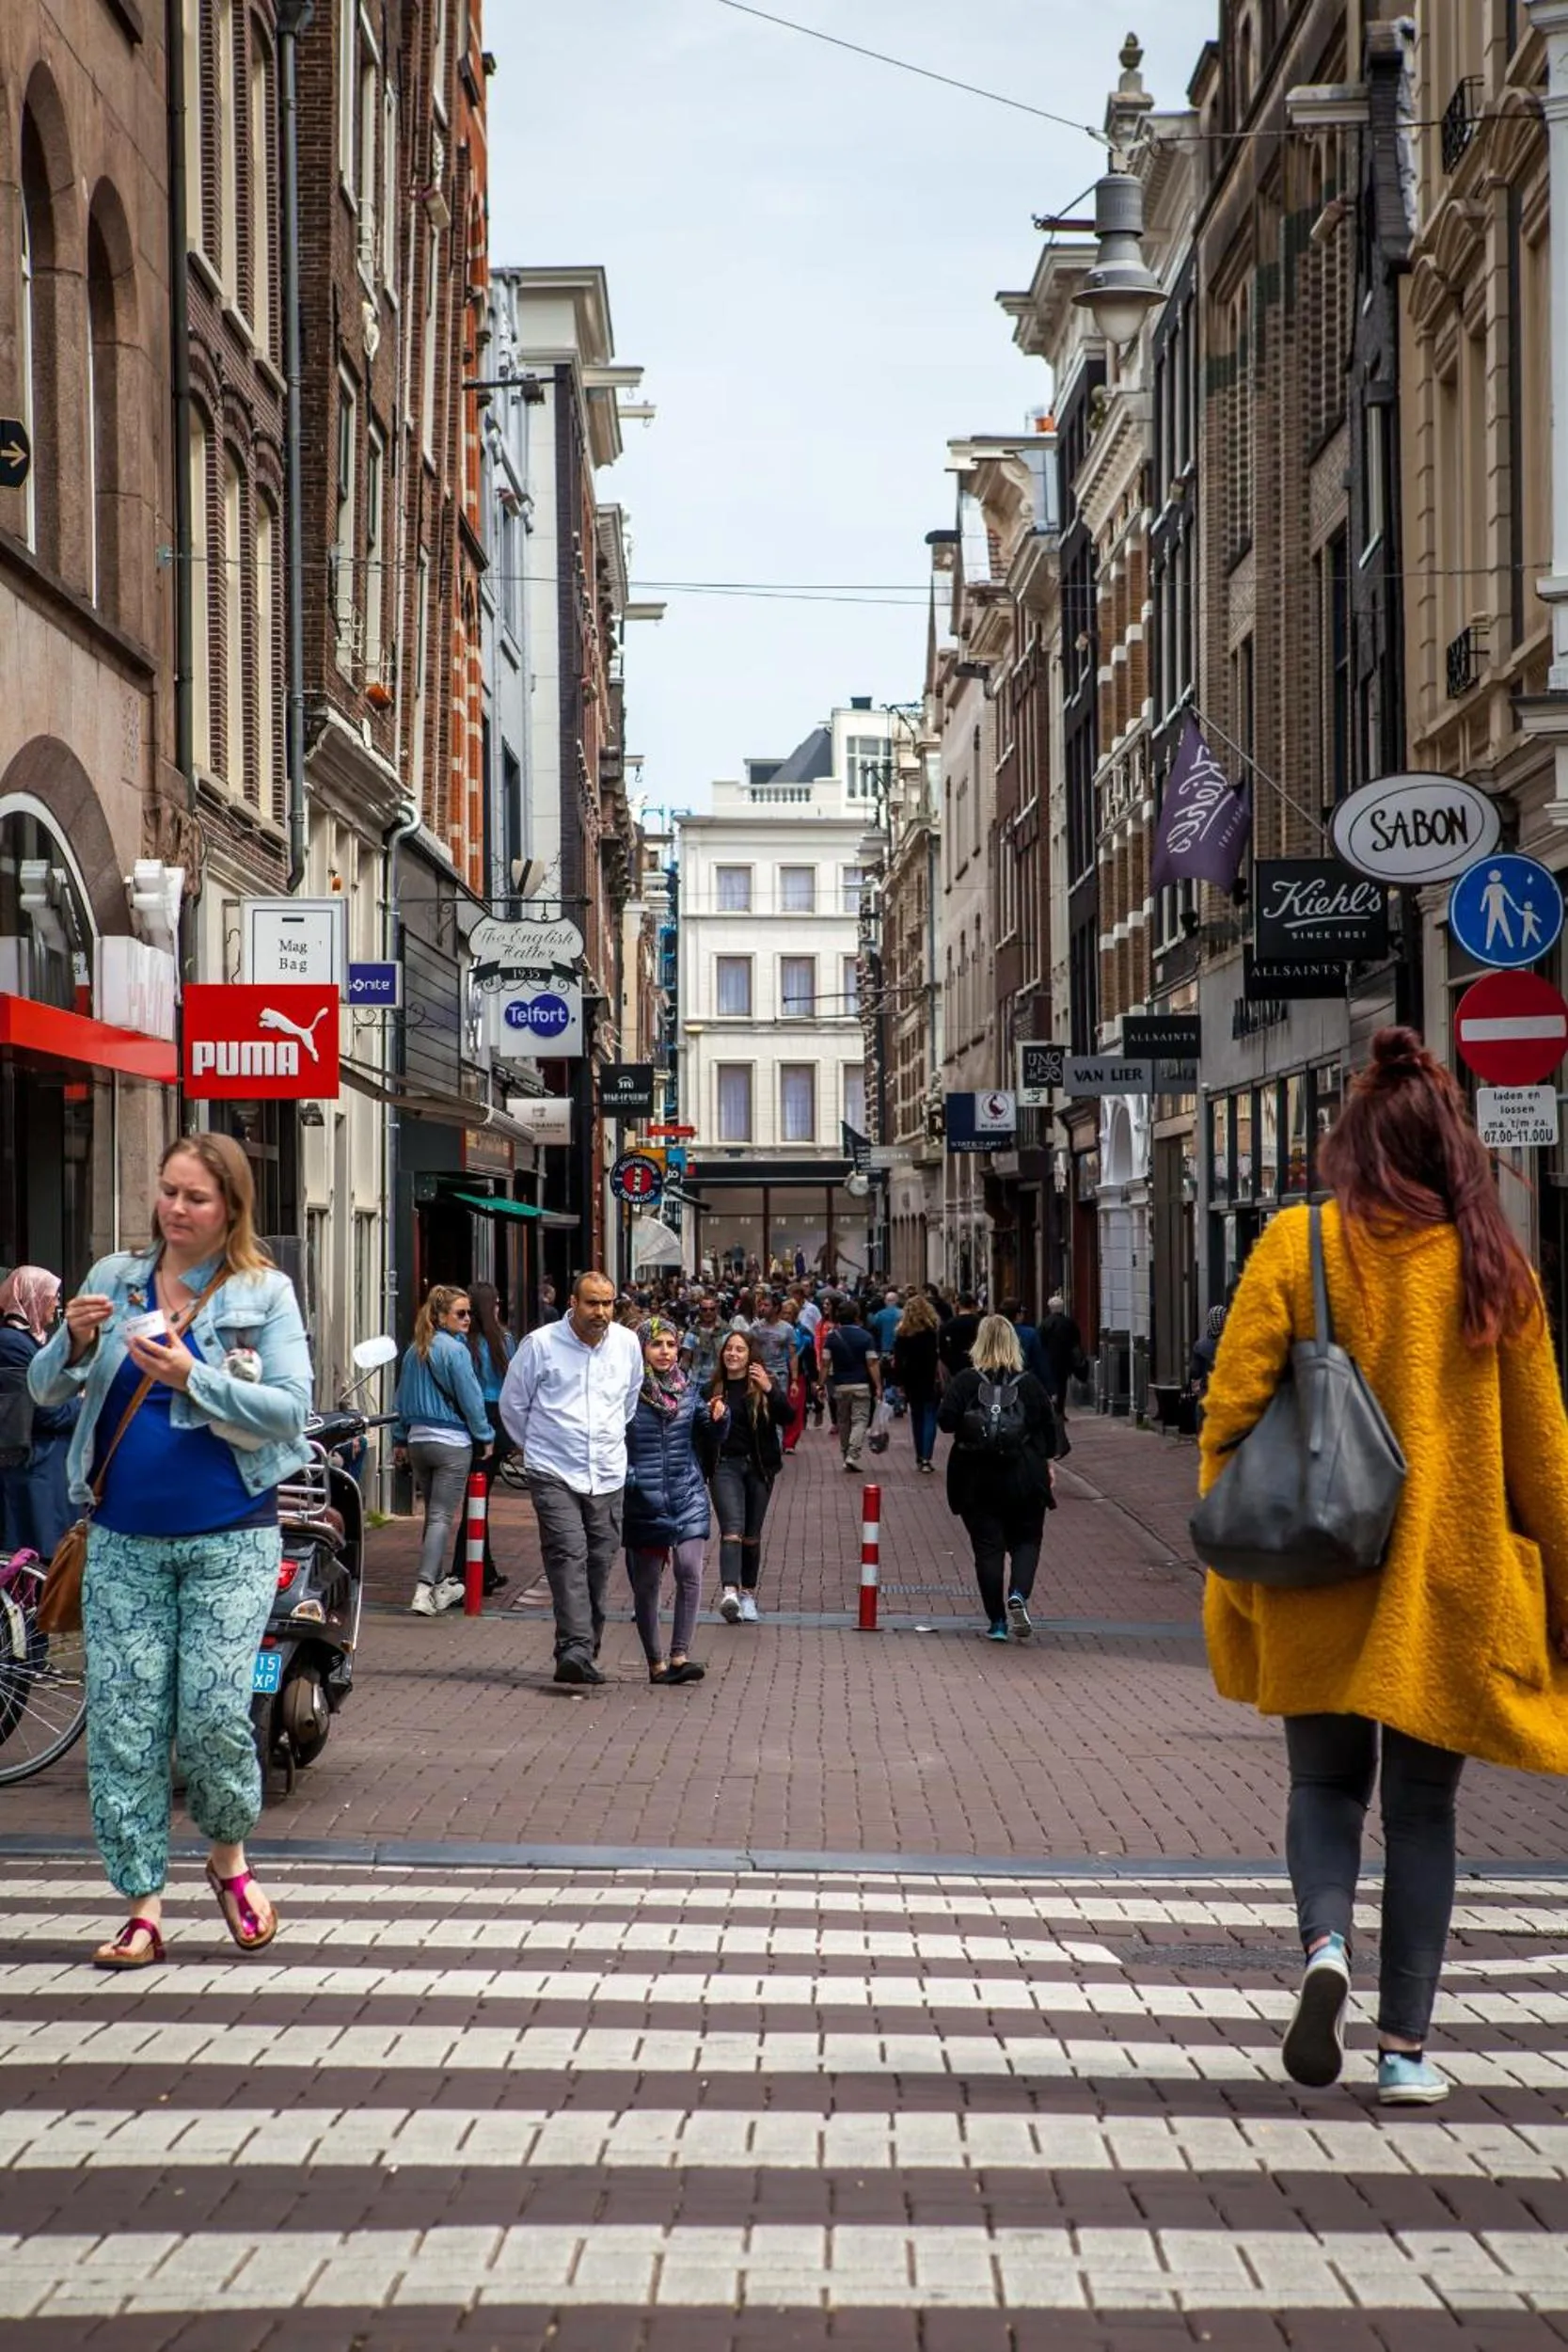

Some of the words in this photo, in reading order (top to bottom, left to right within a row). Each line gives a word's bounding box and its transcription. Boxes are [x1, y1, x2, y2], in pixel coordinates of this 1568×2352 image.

[1370, 805, 1468, 851] SABON
[1262, 878, 1382, 918] Kiehl's
[509, 926, 575, 947] English
[1291, 930, 1331, 940] SINCE
[278, 939, 308, 954] Mag
[278, 958, 308, 973] Bag
[1251, 964, 1340, 977] ALLSAINTS
[513, 968, 540, 979] 1935
[509, 1006, 565, 1024] Telfort
[1130, 1032, 1196, 1041] ALLSAINTS
[192, 1041, 299, 1076] PUMA
[1027, 1052, 1061, 1066] UNO
[1074, 1069, 1104, 1082] VAN
[1111, 1067, 1142, 1081] LIER
[1494, 1091, 1523, 1101] laden
[1499, 1105, 1535, 1114] lossen
[1511, 1119, 1529, 1129] t/m
[1484, 1128, 1553, 1143] 07.00-11.00U
[619, 1187, 656, 1202] TOBACCO
[260, 1657, 276, 1671] 15
[254, 1675, 275, 1688] XP
